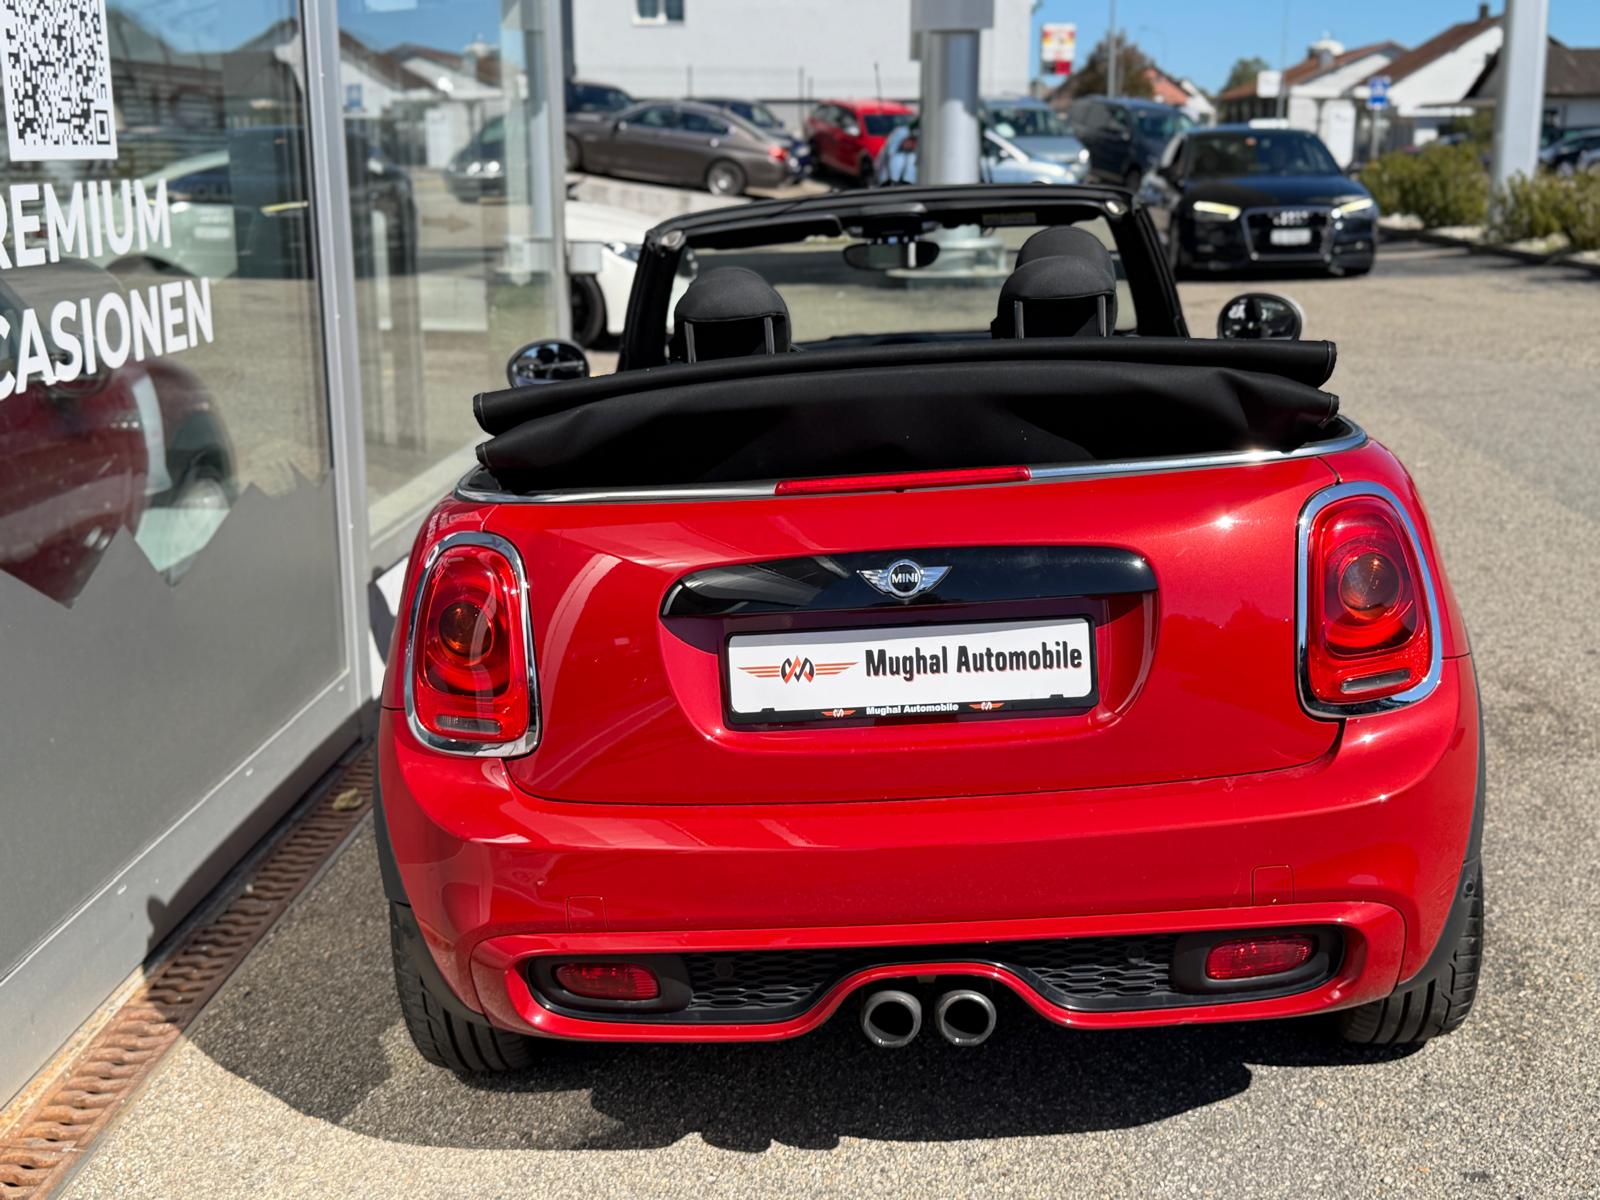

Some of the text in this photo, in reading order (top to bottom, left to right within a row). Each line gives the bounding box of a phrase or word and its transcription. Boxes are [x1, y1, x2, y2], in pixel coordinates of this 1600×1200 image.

[891, 573, 918, 584] MINI
[865, 641, 1083, 682] Mughal Automobile
[866, 702, 959, 716] Mughal Automobile
